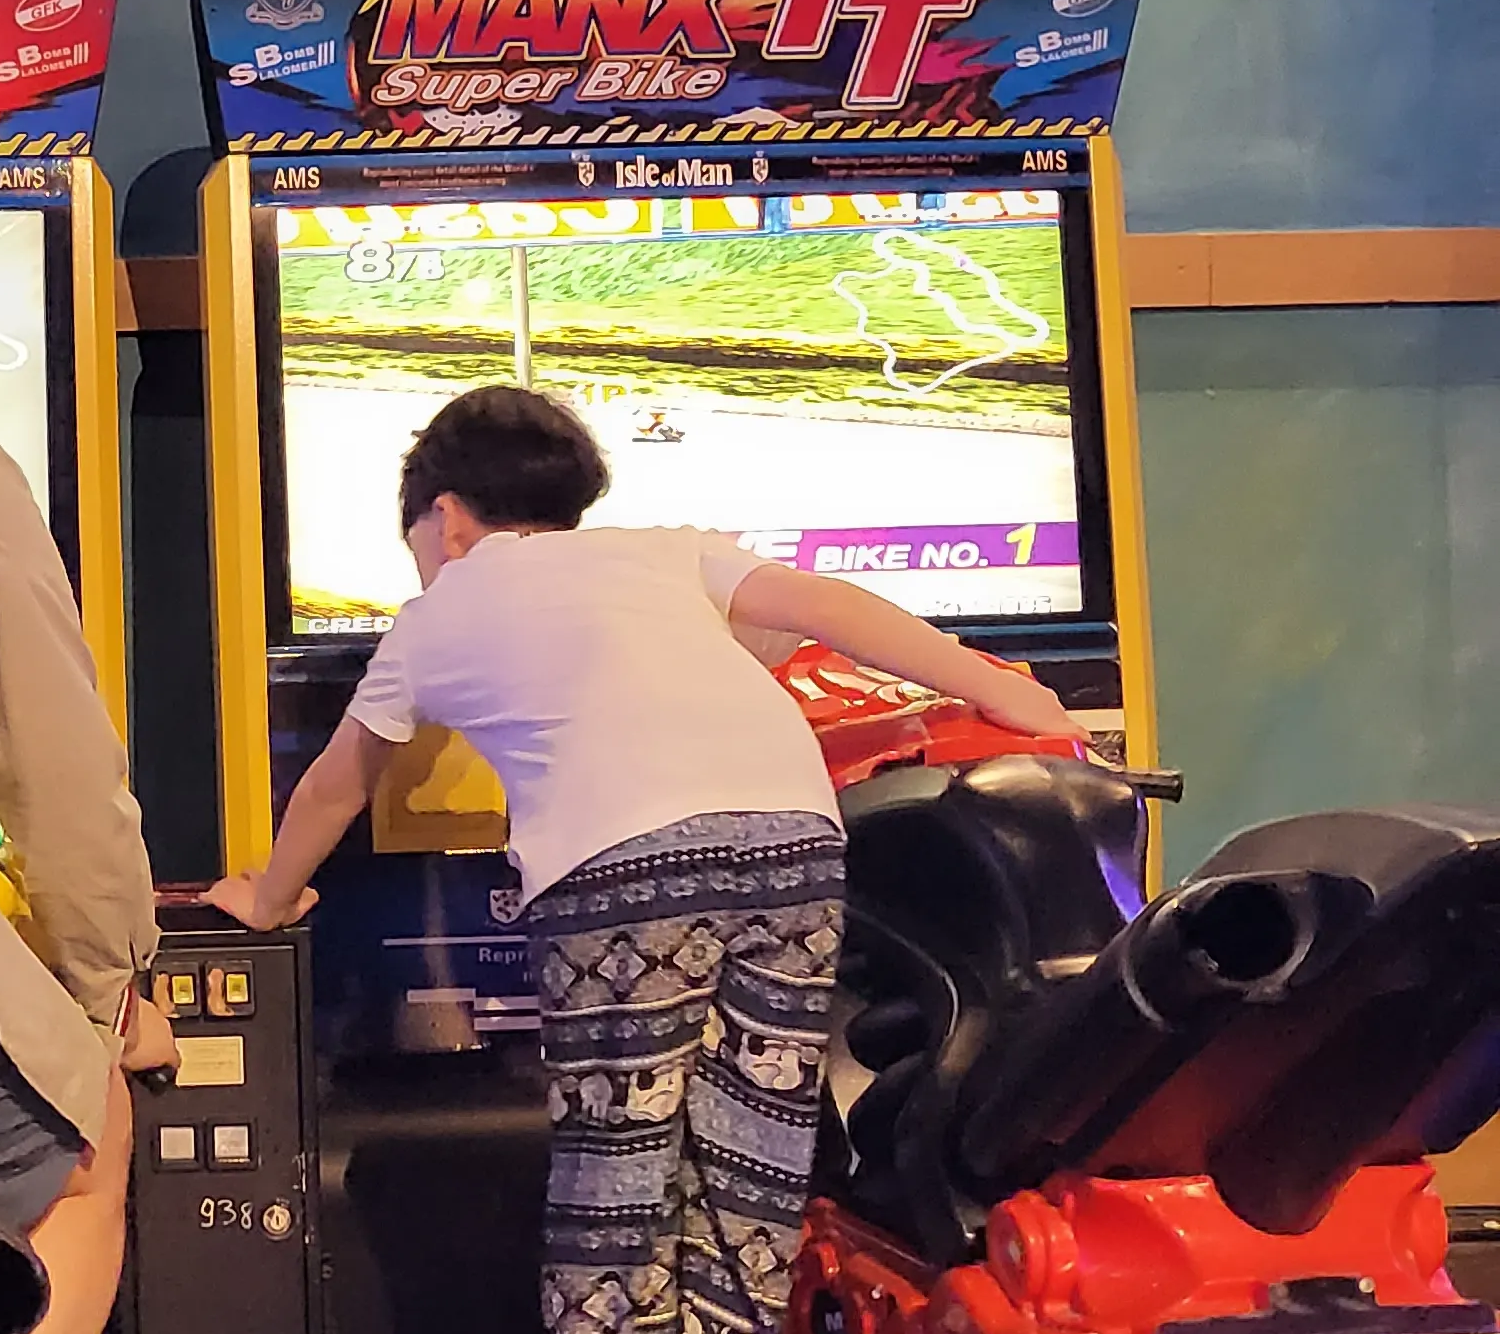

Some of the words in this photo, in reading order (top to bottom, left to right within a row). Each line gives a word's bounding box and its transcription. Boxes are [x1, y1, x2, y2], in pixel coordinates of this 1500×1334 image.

[31, 0, 63, 21] GFK
[372, 63, 580, 112] Super
[575, 57, 732, 101] Bike
[616, 155, 660, 188] Isle
[661, 168, 677, 187] of
[677, 158, 733, 187] Man
[1023, 150, 1068, 171] AMS
[273, 166, 321, 189] AMS
[581, 382, 627, 406] 1P
[813, 542, 913, 572] BIKE
[919, 541, 990, 569] NO.
[1005, 522, 1038, 565] 1
[199, 1195, 253, 1230] 938
